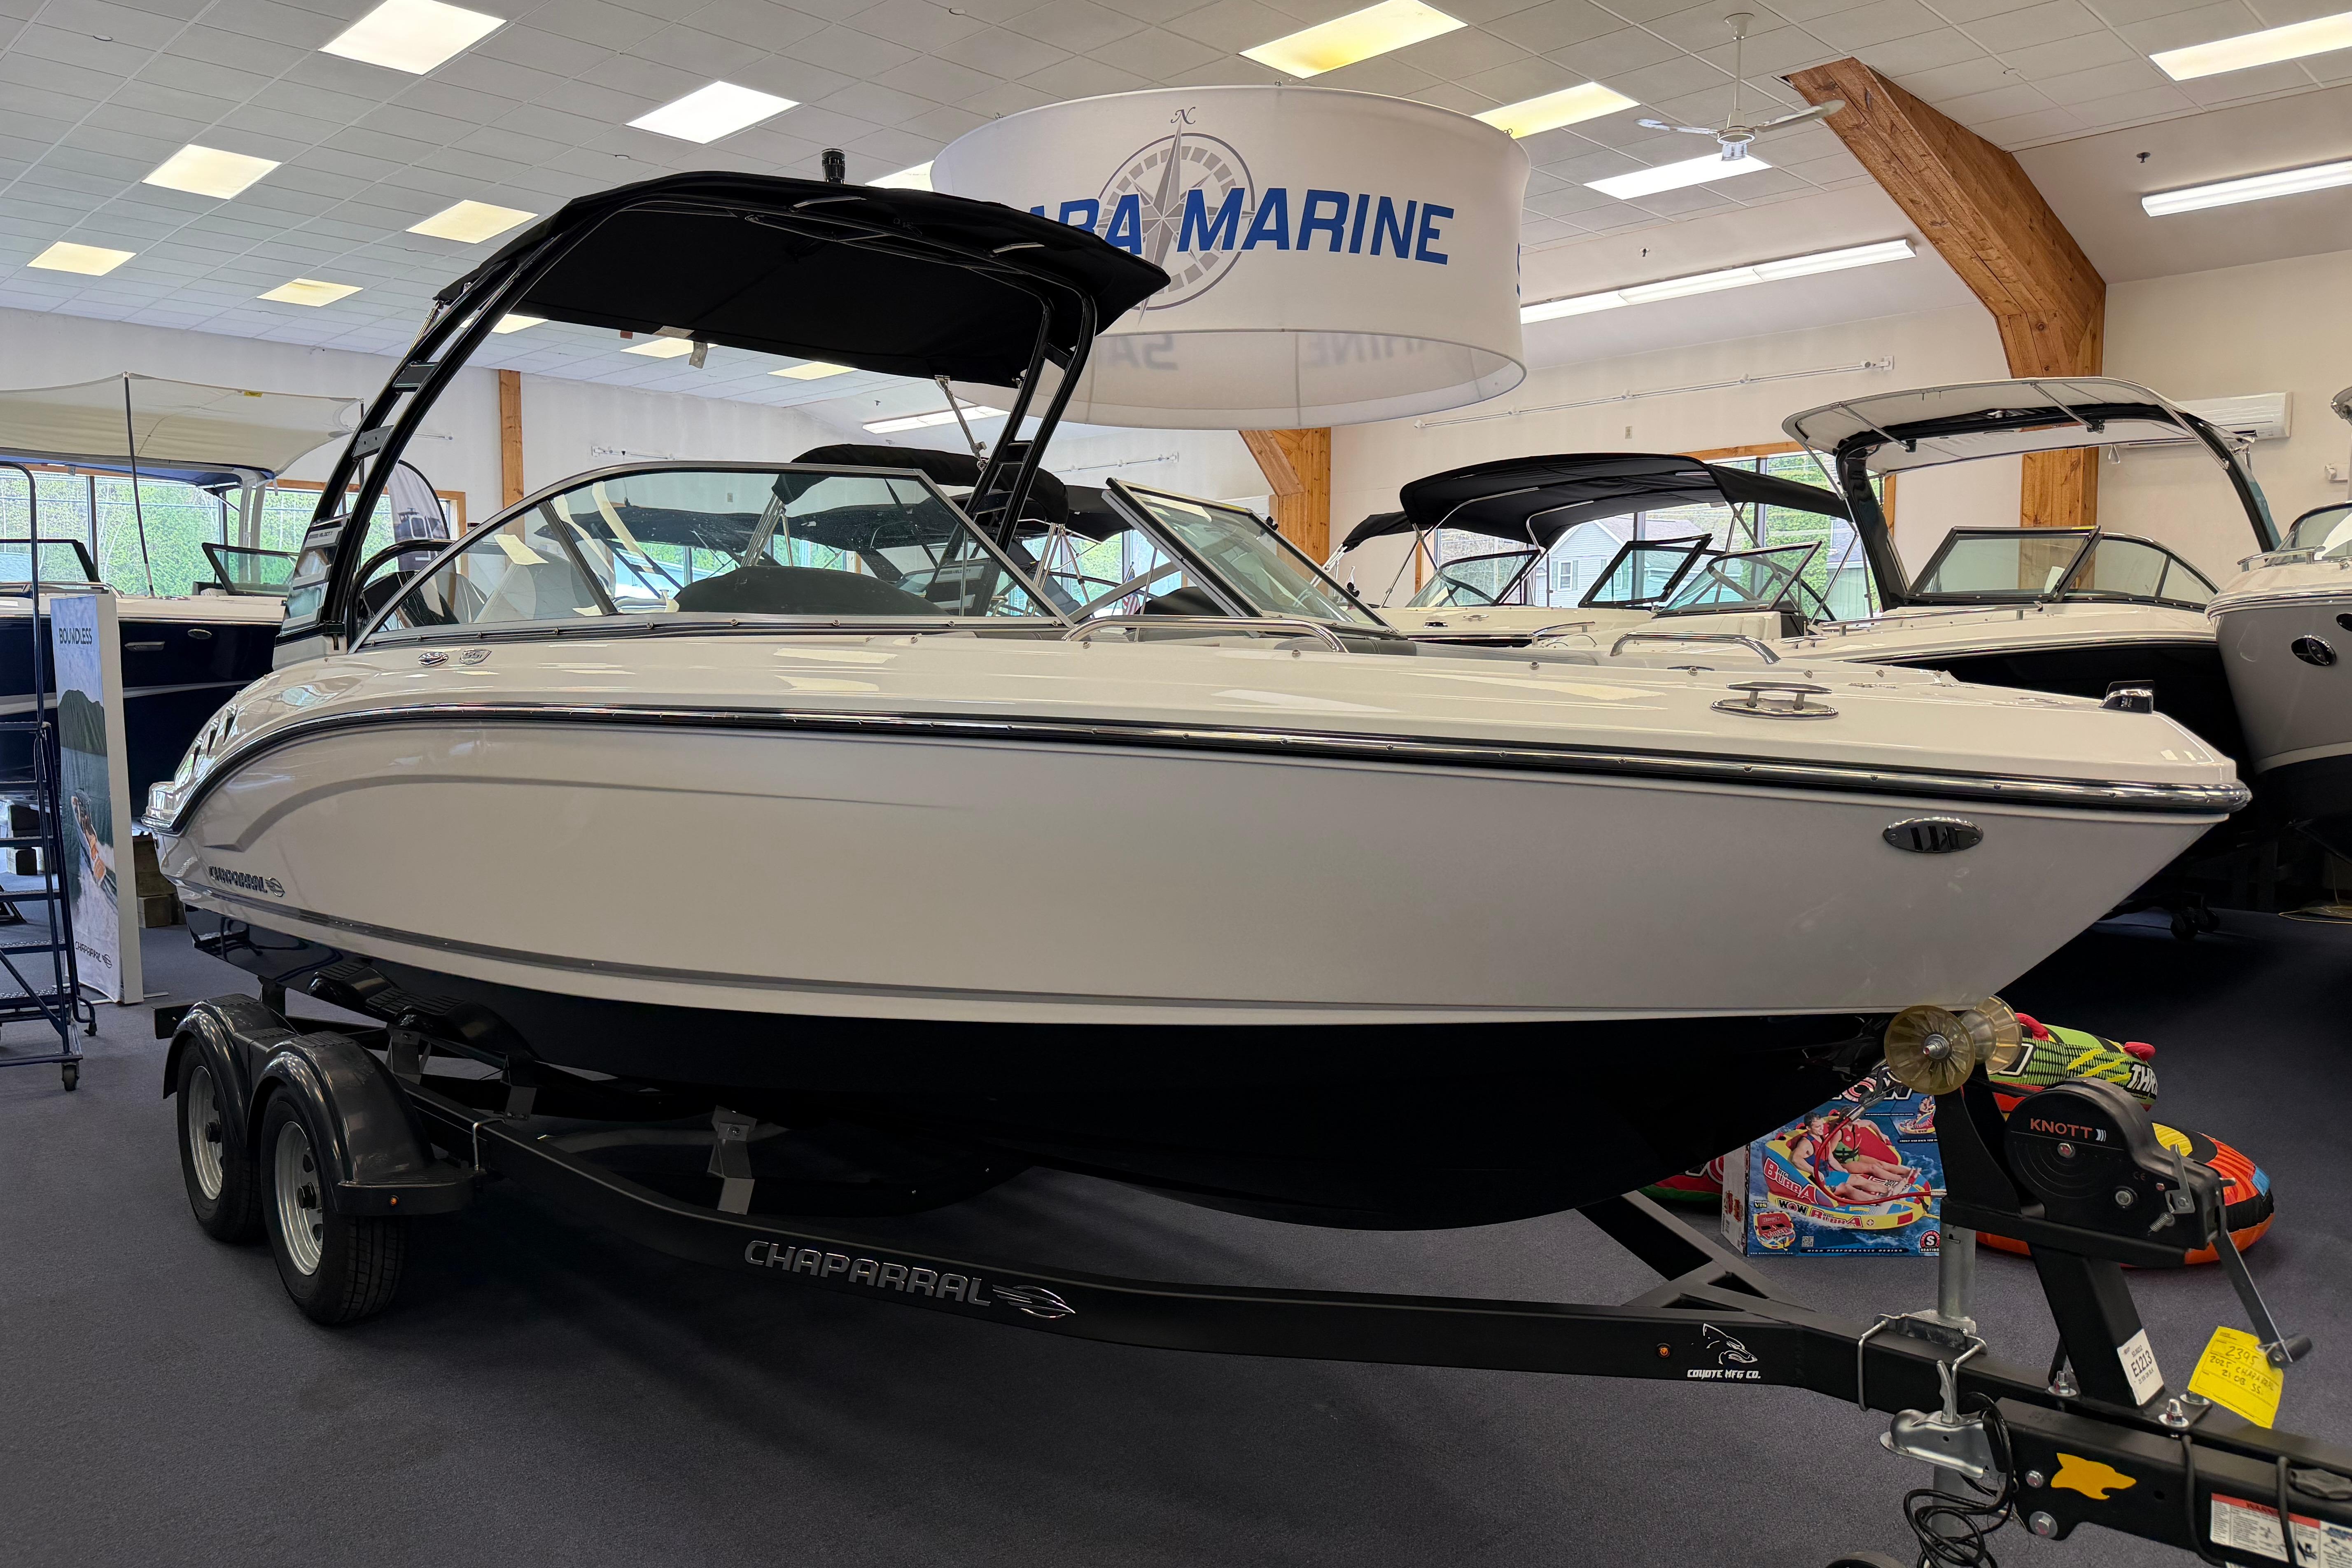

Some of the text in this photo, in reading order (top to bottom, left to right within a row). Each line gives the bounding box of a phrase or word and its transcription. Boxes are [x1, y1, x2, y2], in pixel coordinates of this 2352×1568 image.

[1177, 187, 1454, 265] MARINE
[59, 628, 92, 645] BOUNDLESS
[208, 866, 268, 893] CHAPARRAL
[75, 941, 102, 962] CHAPARRAL
[2030, 1118, 2093, 1139] KNOTT
[1764, 1157, 1818, 1205] BUBBA
[1777, 1168, 1789, 1178] BIG
[1778, 1199, 1808, 1215] WOW
[1810, 1207, 1863, 1228] BUBBA
[1926, 1235, 1935, 1246] S
[744, 1240, 991, 1307] CHAPARRAL
[2130, 1350, 2152, 1378] E1213
[2210, 1355, 2232, 1368] 2025
[2225, 1346, 2259, 1365] 2395
[1687, 1369, 1761, 1380] COYOTE MFG CO.
[2222, 1369, 2231, 1378] 21
[2251, 1384, 2261, 1394] SS
